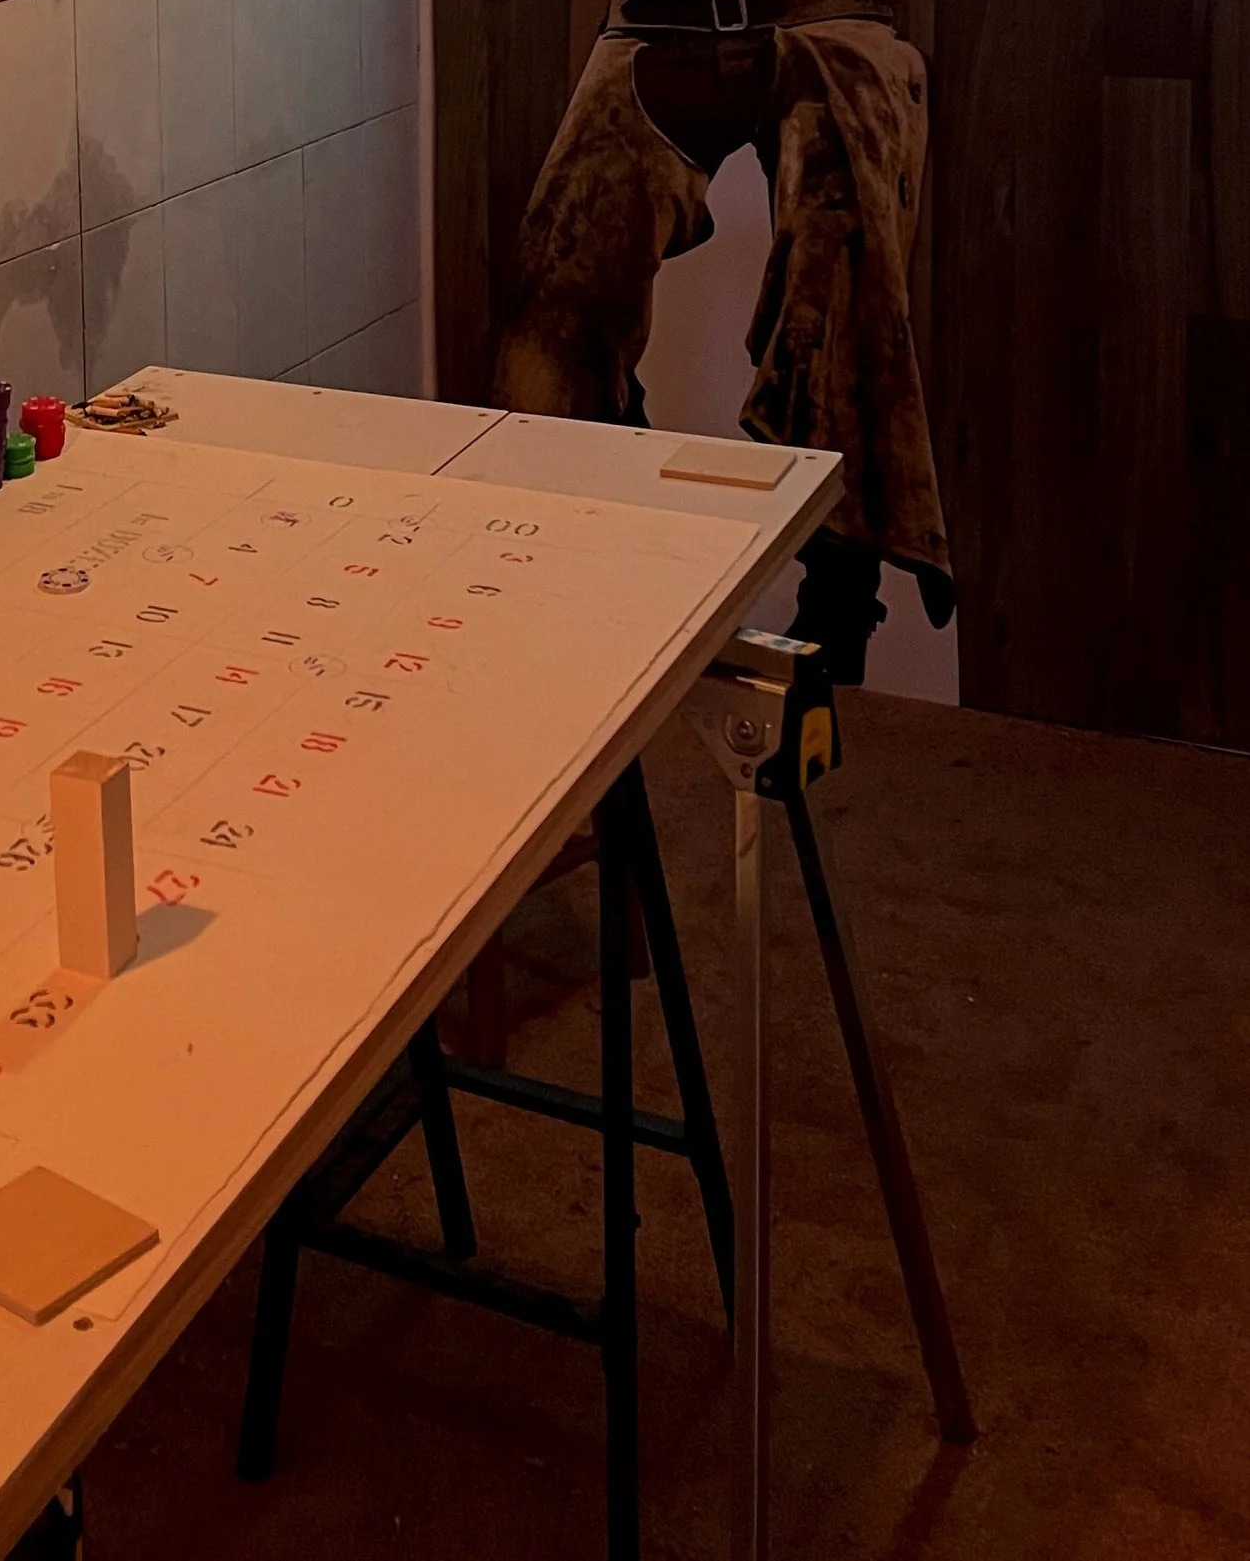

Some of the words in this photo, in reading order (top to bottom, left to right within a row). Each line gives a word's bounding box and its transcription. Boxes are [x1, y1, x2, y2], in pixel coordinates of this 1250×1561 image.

[486, 519, 539, 536] 00
[64, 529, 144, 571] DOZE
[136, 605, 178, 623] 10
[261, 631, 301, 645] 11
[88, 640, 133, 658] 13
[384, 652, 430, 672] 12
[215, 666, 259, 684] 14
[37, 677, 83, 696] 16
[345, 691, 391, 712] 15
[170, 705, 212, 727] 17
[301, 732, 347, 752] 18
[253, 774, 301, 797] 21
[199, 820, 254, 848] 24
[147, 869, 200, 906] 27
[10, 989, 73, 1028] 33
